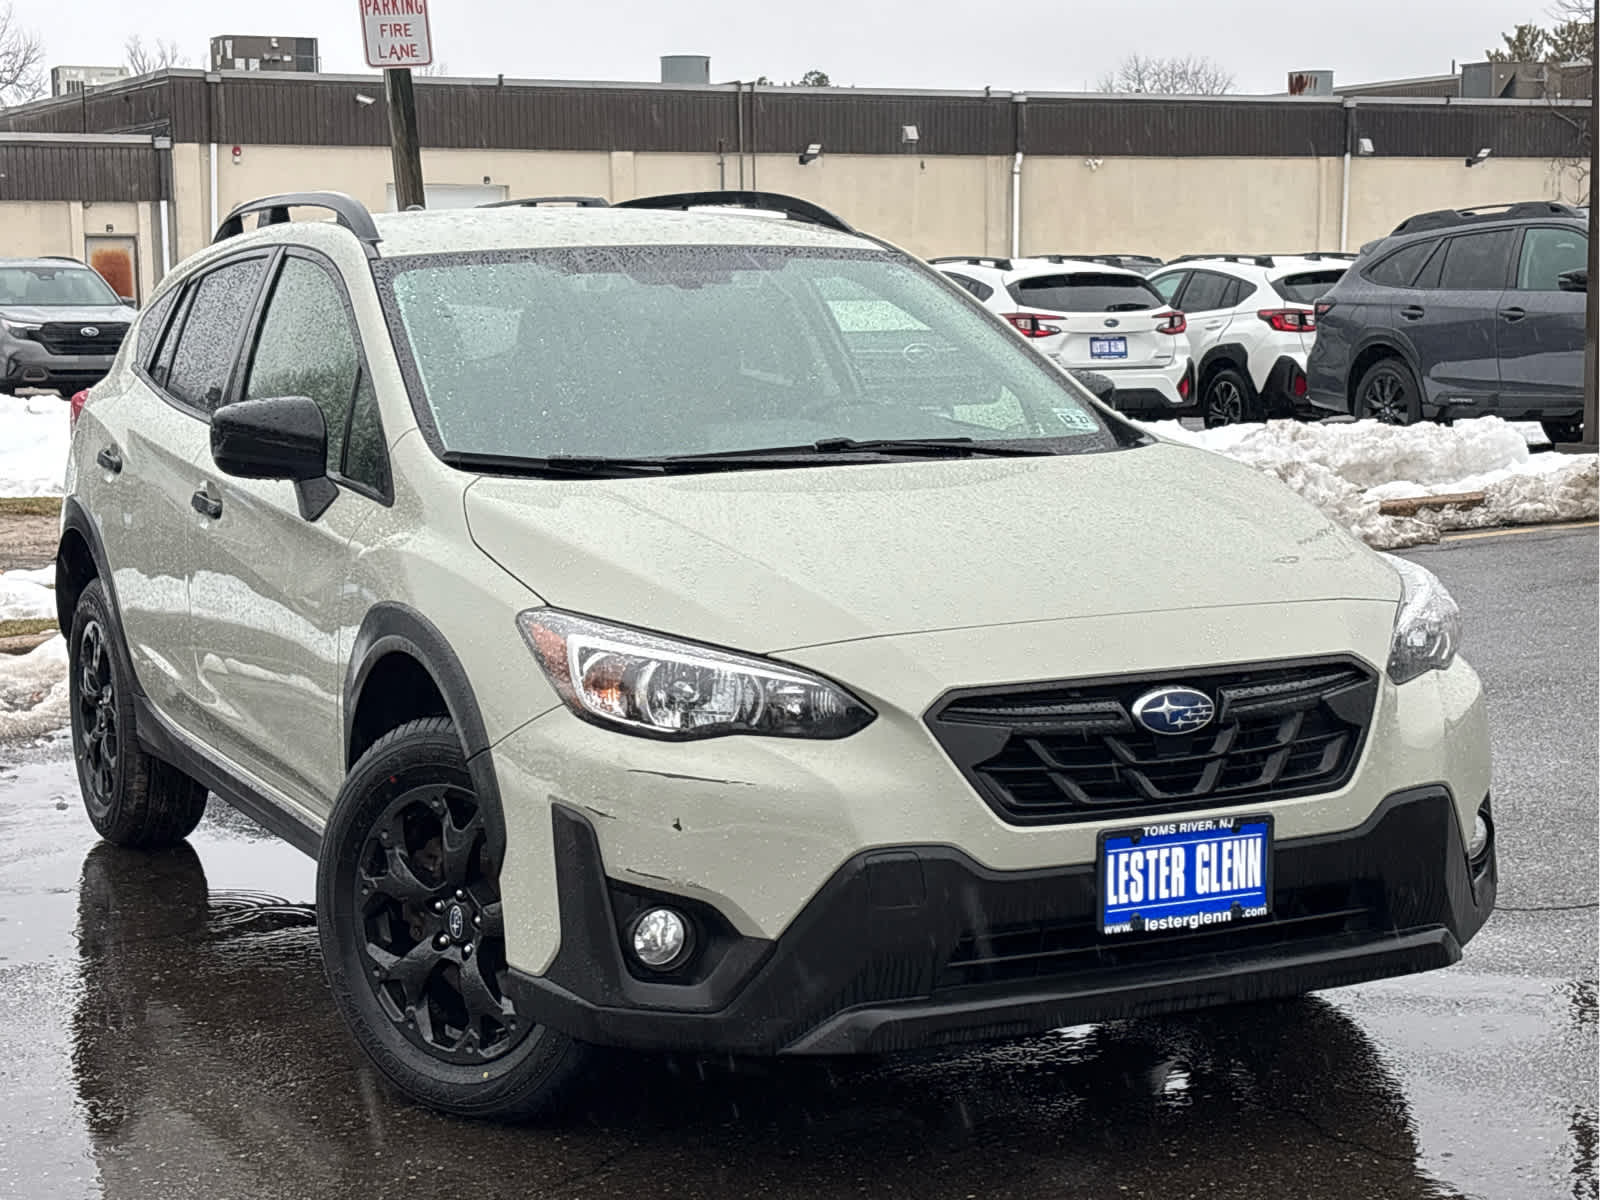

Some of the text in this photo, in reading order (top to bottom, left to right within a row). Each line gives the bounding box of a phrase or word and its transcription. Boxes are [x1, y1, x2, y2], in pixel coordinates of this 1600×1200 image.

[365, 0, 423, 16] PARKING
[380, 23, 413, 38] FIRE
[378, 43, 420, 59] LANE
[1143, 824, 1176, 837] TOMS
[1219, 818, 1234, 829] NJ
[1107, 837, 1262, 906] LESTER GLENN
[1104, 922, 1133, 935] www.
[1144, 911, 1232, 932] lesterglenn
